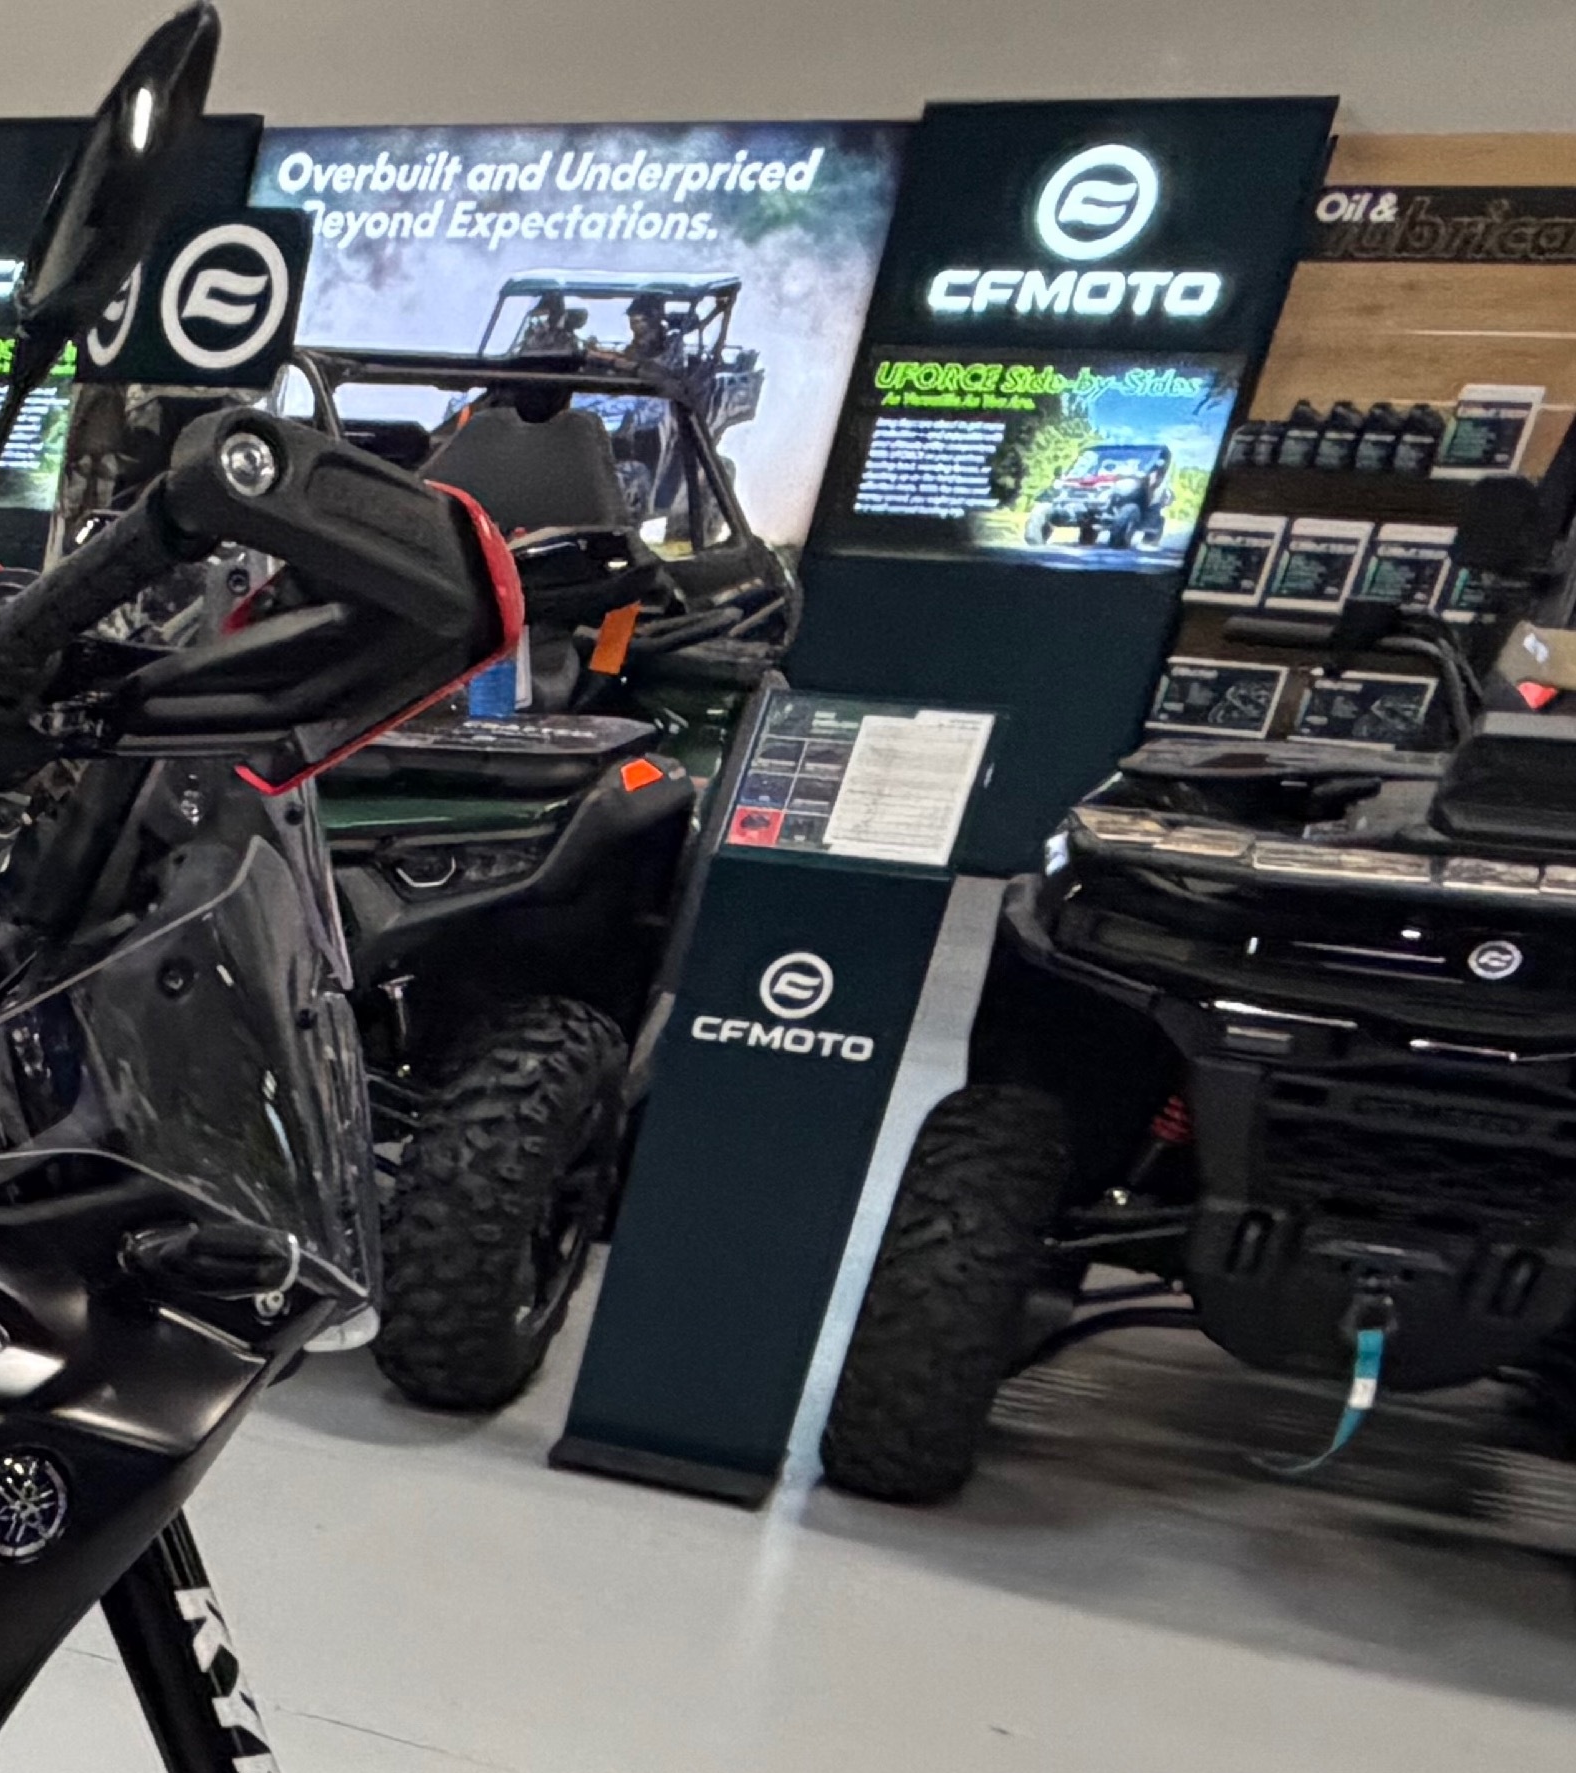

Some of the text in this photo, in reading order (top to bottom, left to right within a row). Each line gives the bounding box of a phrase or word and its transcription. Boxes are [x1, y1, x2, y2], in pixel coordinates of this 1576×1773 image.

[278, 147, 825, 202] Overbuilt and Underpriced
[447, 199, 718, 250] Expectations.
[1315, 191, 1399, 222] Oil &
[927, 266, 1224, 317] CFMOTO
[691, 1015, 874, 1061] CFMOTO
